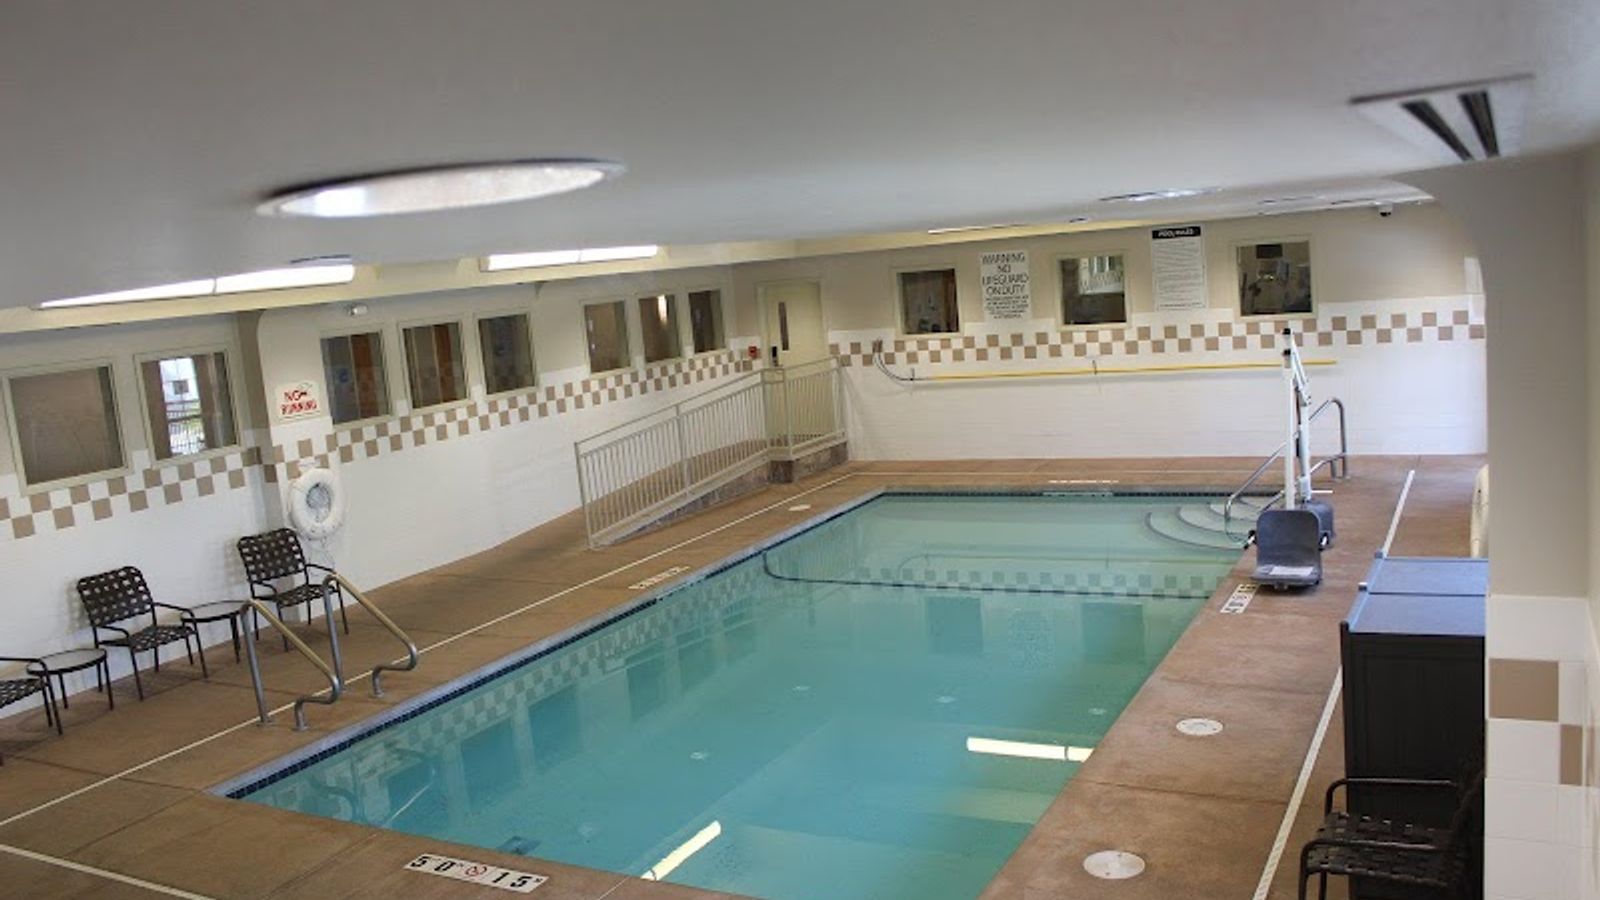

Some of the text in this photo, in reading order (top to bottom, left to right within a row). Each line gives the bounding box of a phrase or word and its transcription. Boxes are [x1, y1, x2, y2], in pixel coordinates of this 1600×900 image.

[982, 252, 1026, 265] WARNING
[998, 264, 1011, 273] NO
[982, 273, 1029, 286] LIFEGUARD
[986, 284, 1025, 296] ON DUTY
[284, 390, 300, 401] NO
